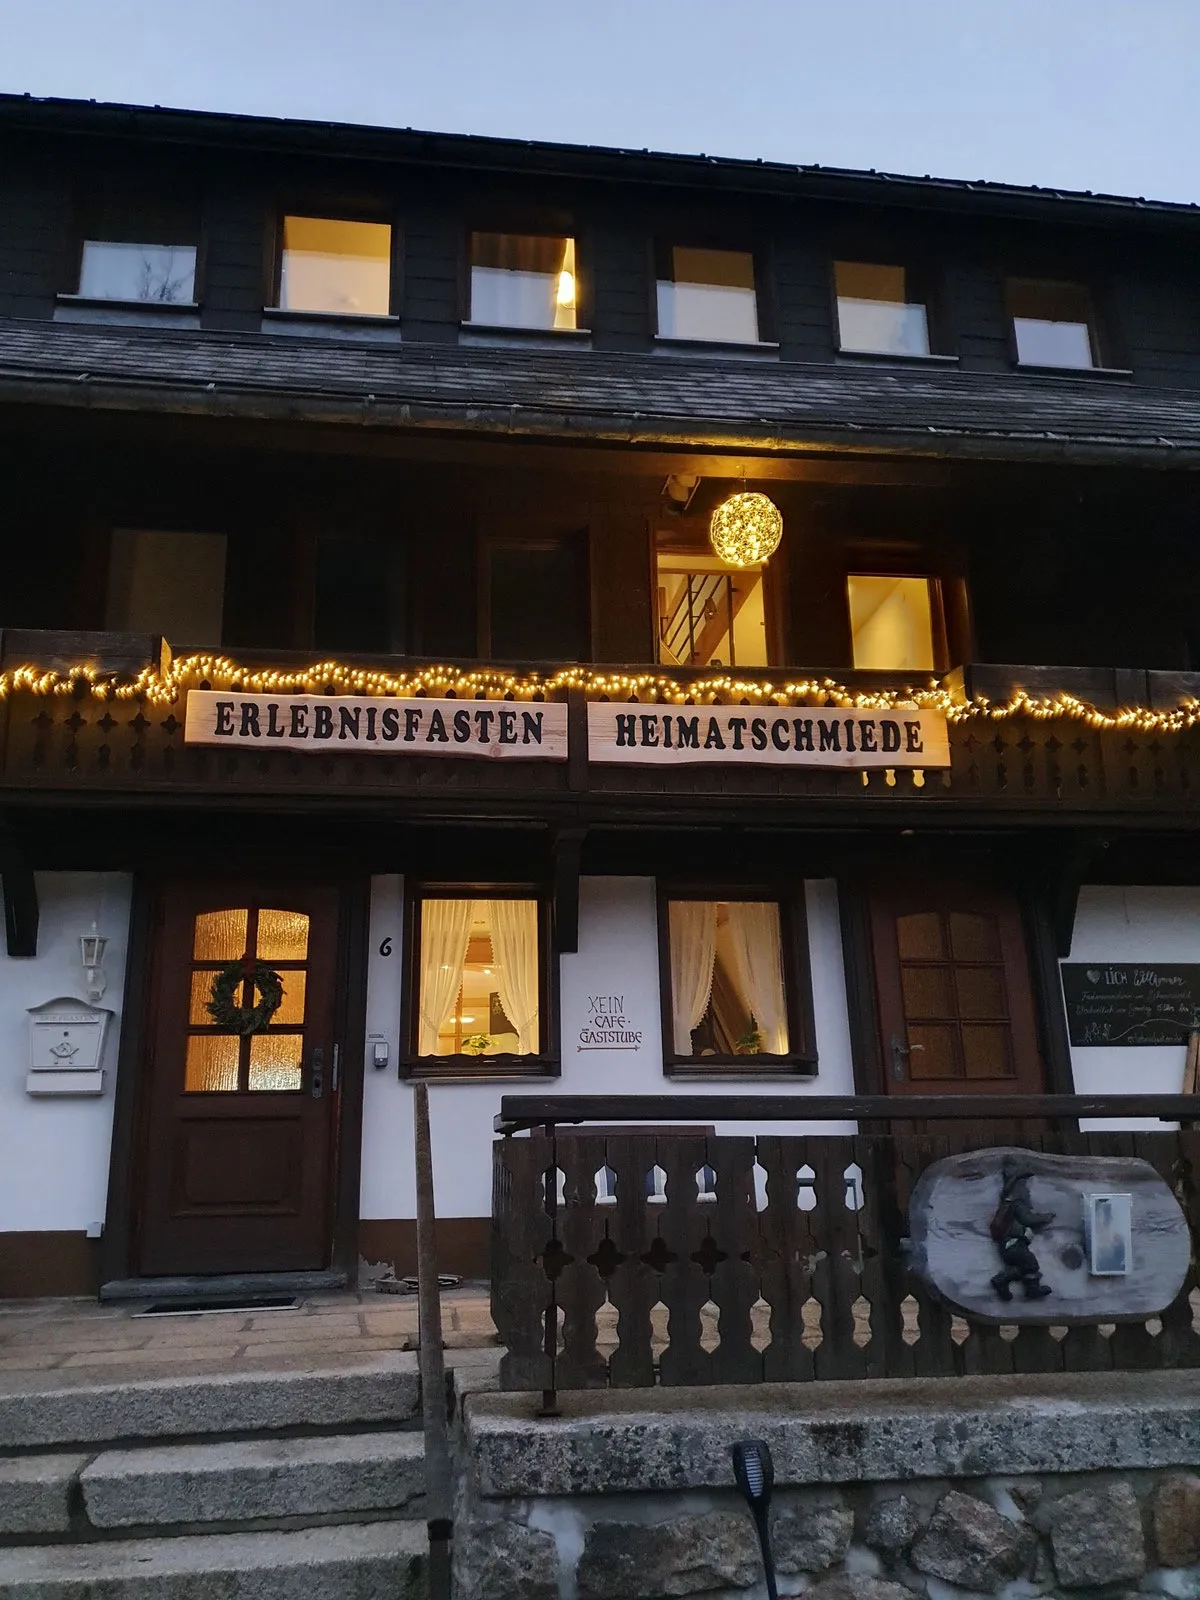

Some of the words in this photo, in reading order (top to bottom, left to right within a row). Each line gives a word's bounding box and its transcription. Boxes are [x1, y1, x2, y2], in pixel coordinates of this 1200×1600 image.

[214, 701, 545, 745] ERLEBNISFASTEN
[615, 713, 924, 753] HEIMATSCHMIEDE
[379, 936, 393, 957] 6
[579, 1030, 643, 1044] GASTSTUBE
